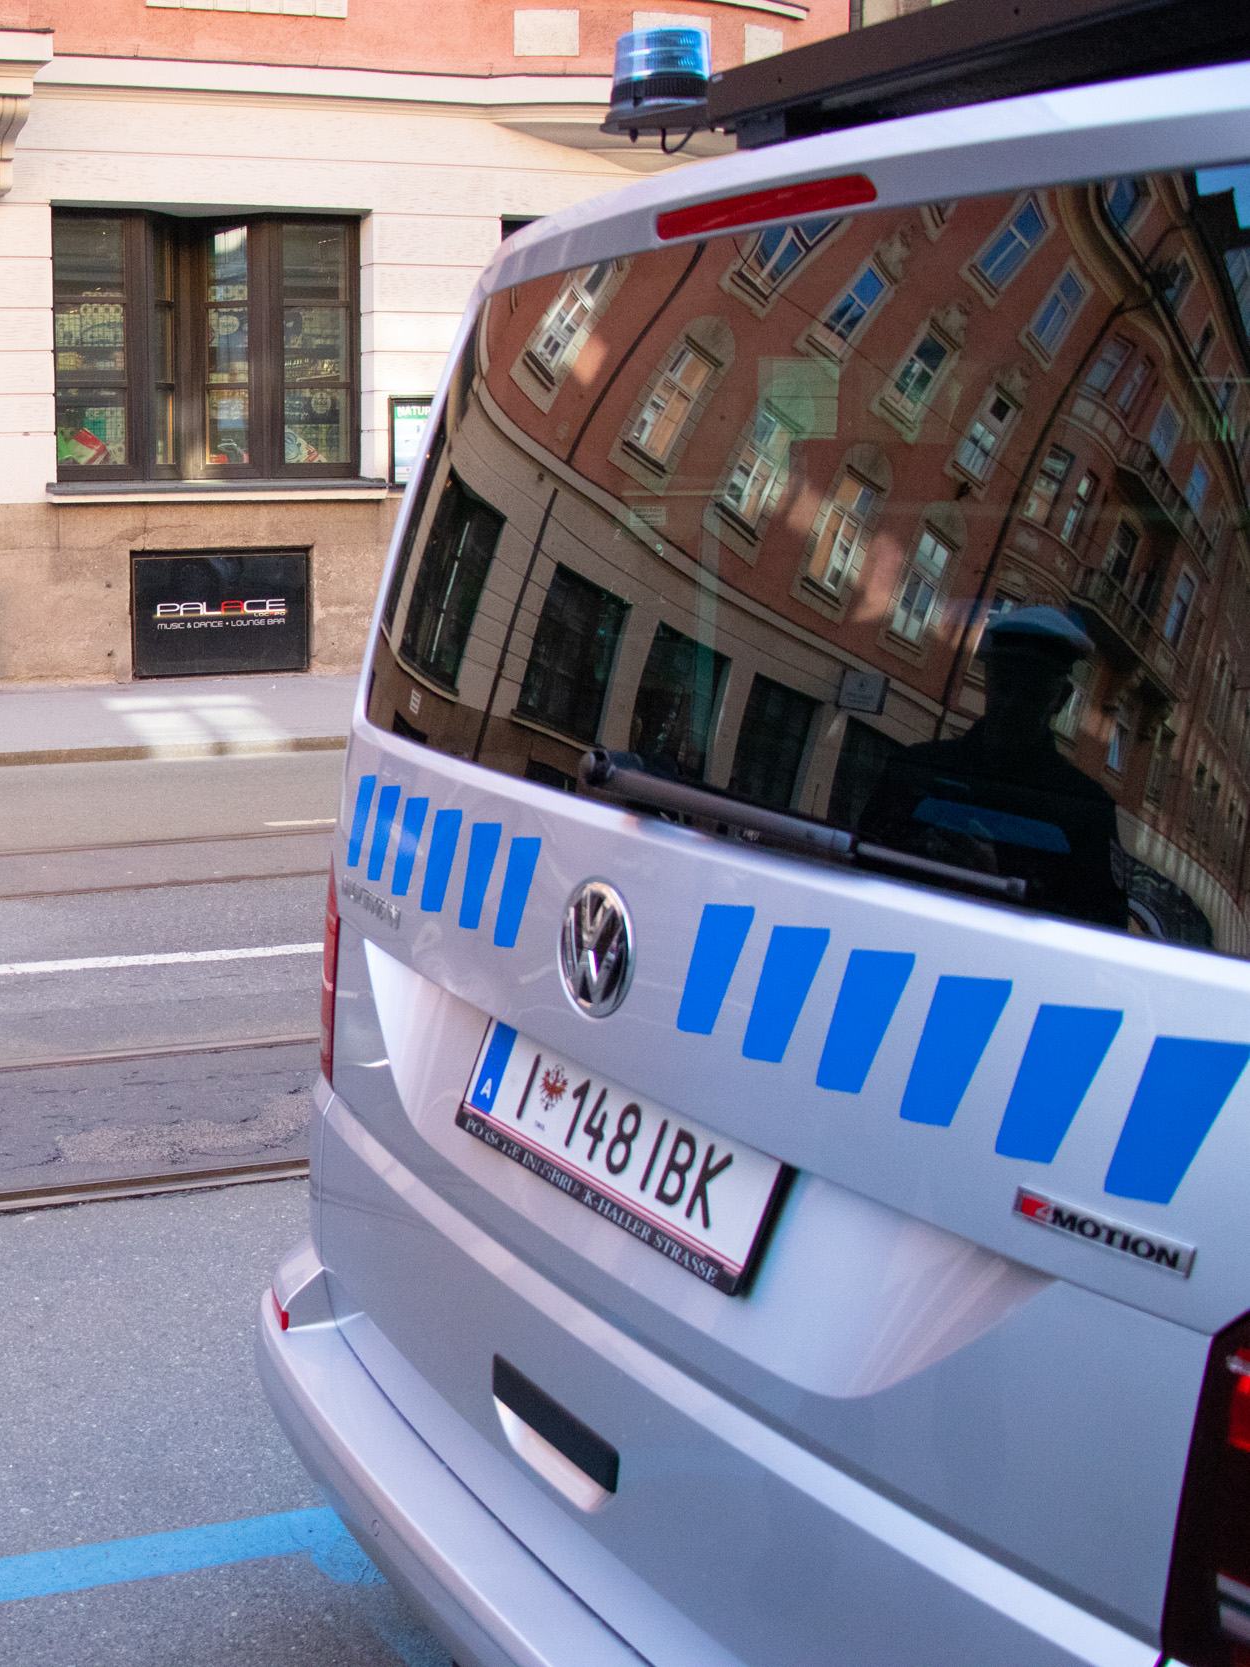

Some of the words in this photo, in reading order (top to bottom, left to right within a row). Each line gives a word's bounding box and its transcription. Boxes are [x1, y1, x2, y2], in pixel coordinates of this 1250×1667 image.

[156, 598, 286, 617] PALACE
[156, 622, 185, 630] MUSIC
[193, 620, 224, 628] DANCE
[230, 618, 265, 627] LOUNGE
[267, 617, 286, 625] BAR
[479, 1078, 493, 1099] A
[516, 1053, 541, 1120] I
[564, 1078, 642, 1175] 148
[639, 1118, 733, 1230] IBK
[654, 1228, 719, 1282] STRASSE
